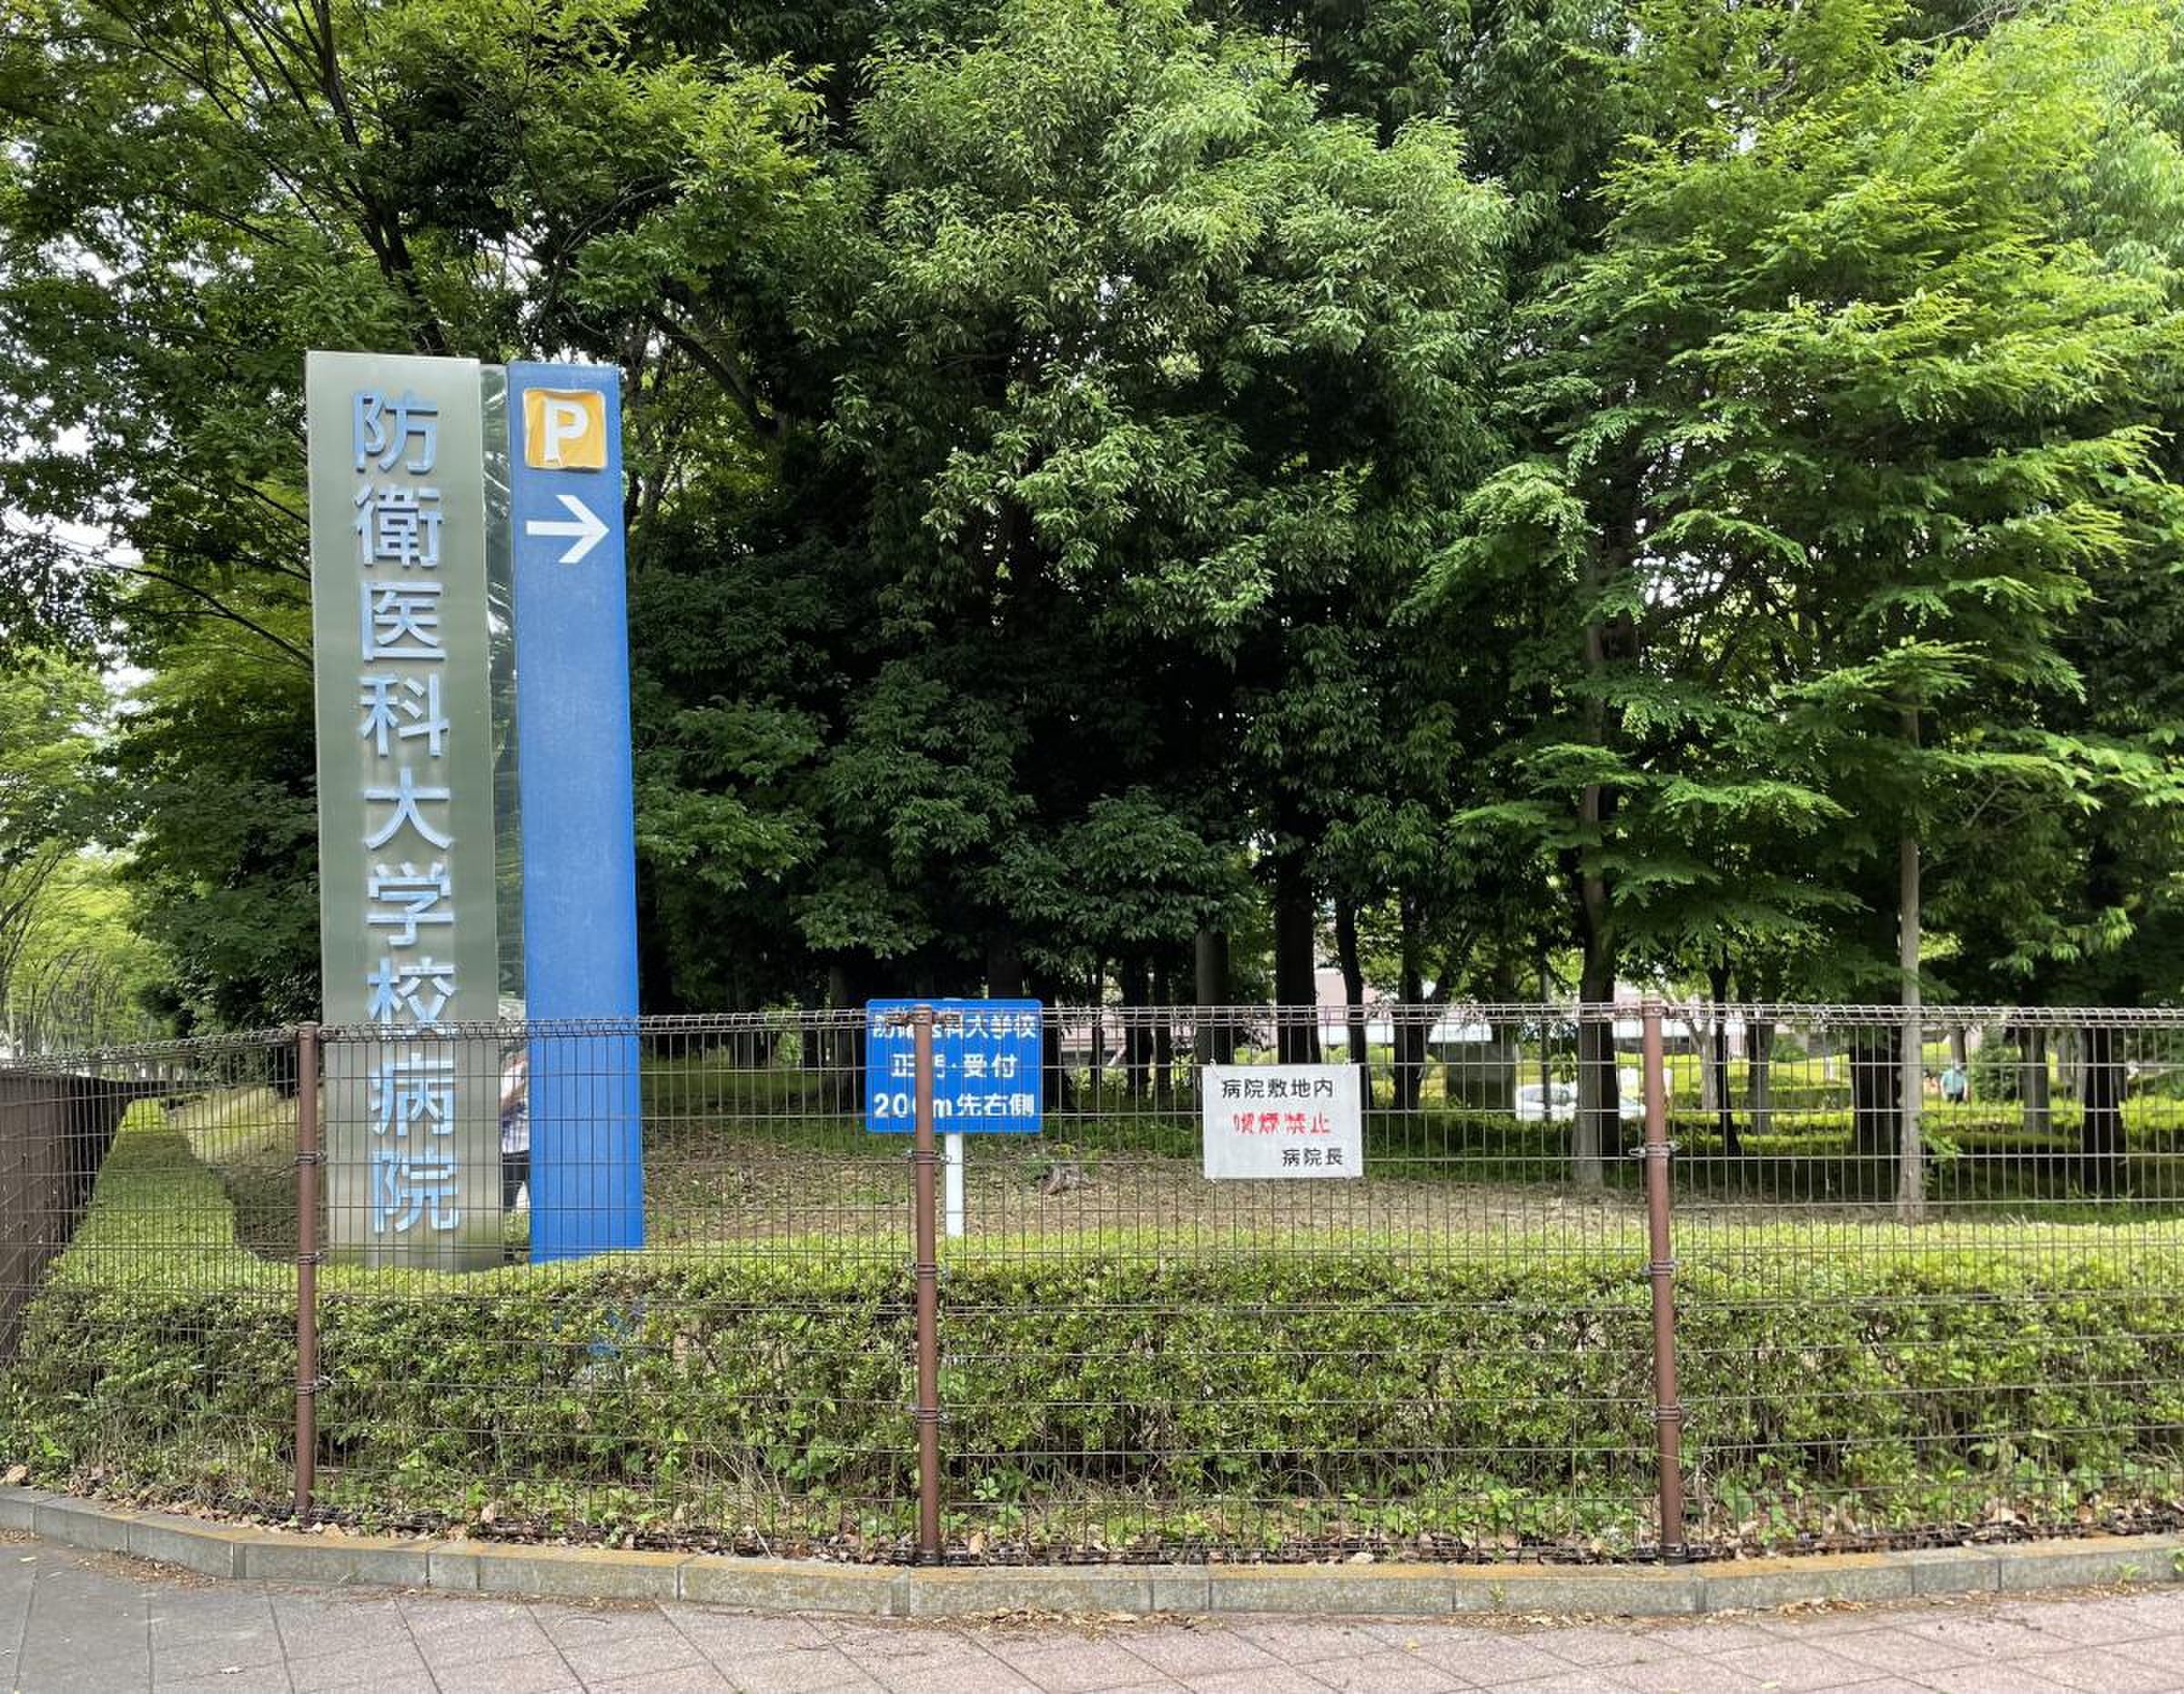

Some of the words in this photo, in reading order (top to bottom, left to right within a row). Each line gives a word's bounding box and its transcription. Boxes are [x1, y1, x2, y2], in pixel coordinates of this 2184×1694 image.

[542, 398, 589, 462] P
[351, 391, 460, 1234] 防衛医科大学校病院
[1222, 1079, 1333, 1098] 病院敷地内
[874, 1093, 1035, 1118] 20m先右側
[1233, 1112, 1330, 1134] 喫煙禁止
[1282, 1147, 1344, 1165] 病院長
